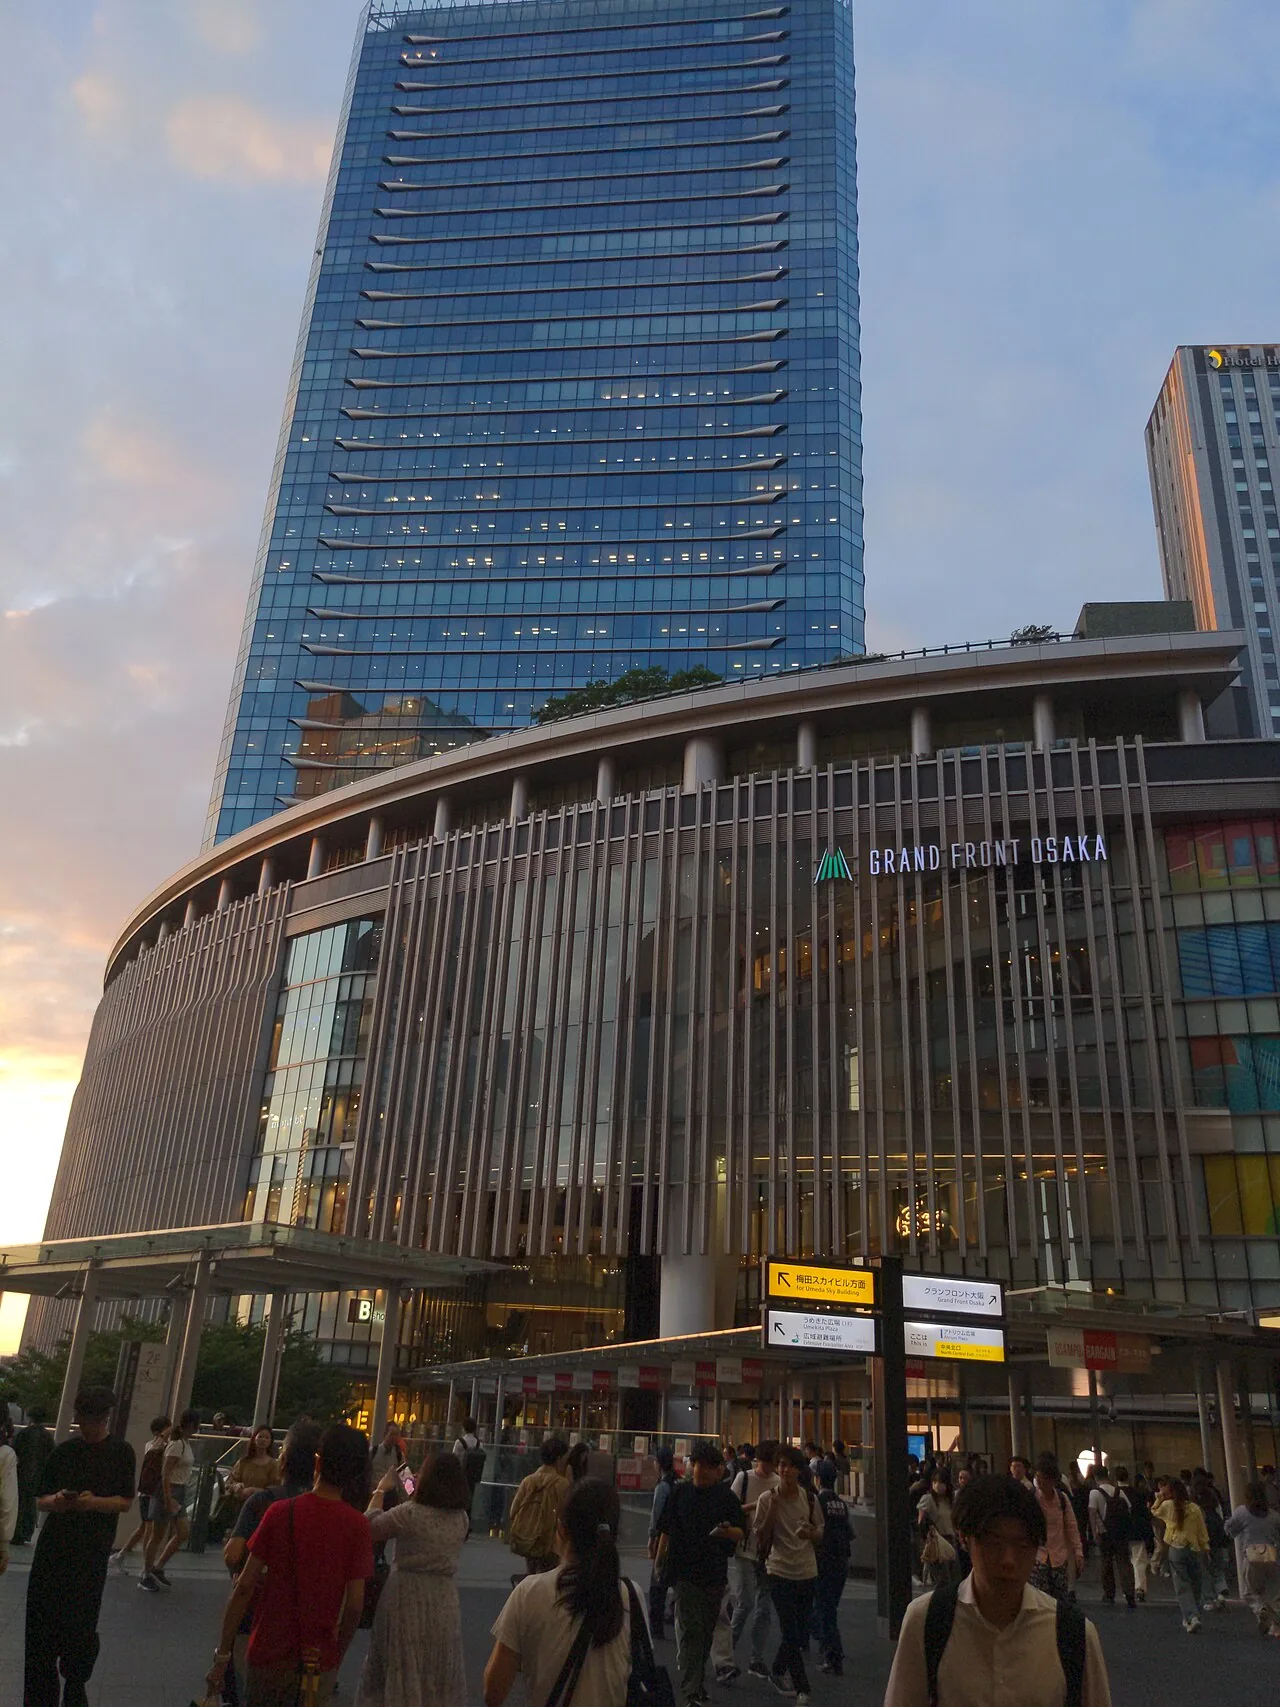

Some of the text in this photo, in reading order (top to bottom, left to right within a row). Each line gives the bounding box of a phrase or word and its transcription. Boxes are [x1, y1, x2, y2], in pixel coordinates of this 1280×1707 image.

[1224, 355, 1280, 366] Hotel H
[870, 834, 1107, 875] GRAND FRONT OSAKA
[796, 1274, 866, 1290] 梅田スカイビル方面
[826, 1287, 836, 1295] Sky
[837, 1288, 860, 1296] Building
[924, 1287, 985, 1300] グランフロント大阪
[969, 1299, 985, 1307] Osaka
[358, 1300, 371, 1321] B
[803, 1316, 840, 1326] うめきた広場
[910, 1333, 928, 1341] ここは
